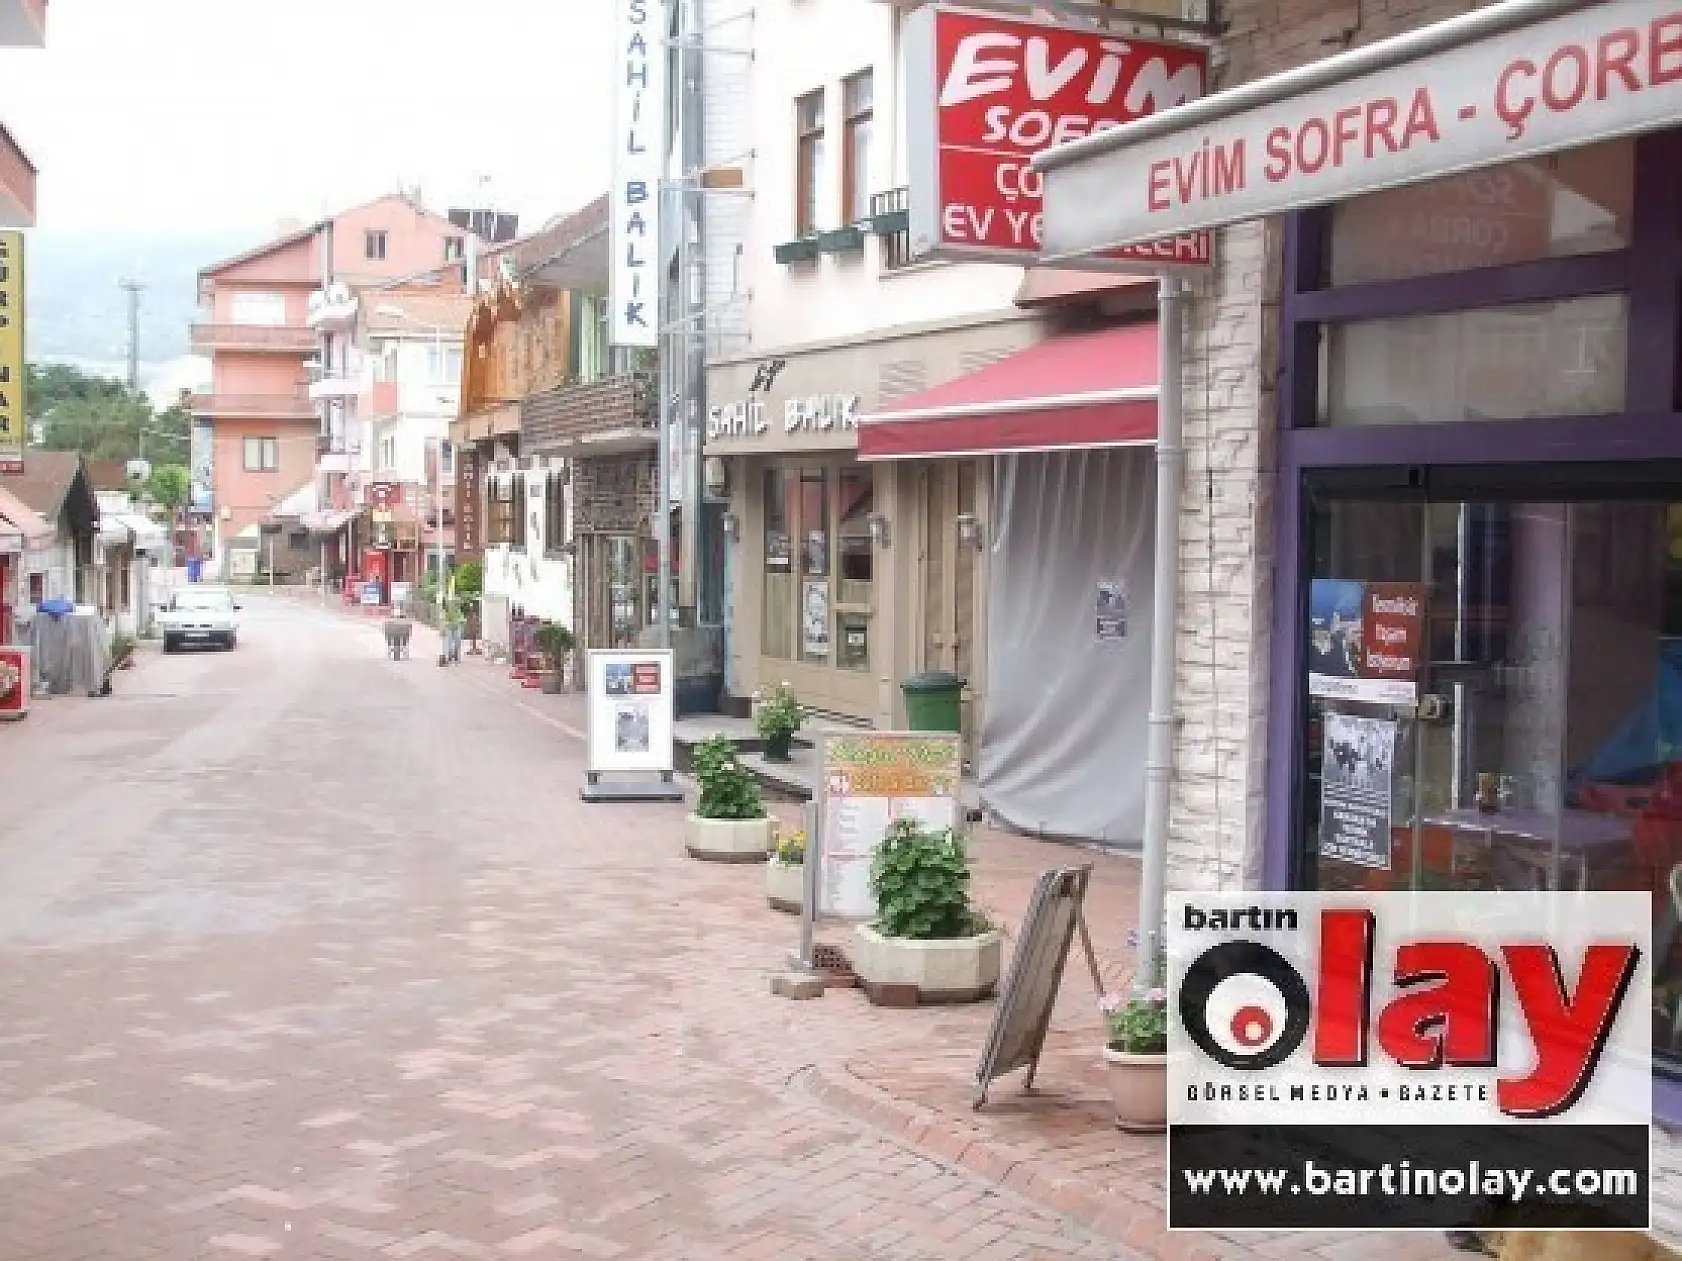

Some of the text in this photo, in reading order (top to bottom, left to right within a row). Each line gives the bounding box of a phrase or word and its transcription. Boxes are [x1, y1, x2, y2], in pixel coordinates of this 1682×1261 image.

[938, 31, 1202, 113] EVİM
[1147, 136, 1248, 213] EVİM
[1263, 87, 1441, 183] SOFRA
[625, 181, 648, 328] BALIK
[943, 202, 994, 241] EV
